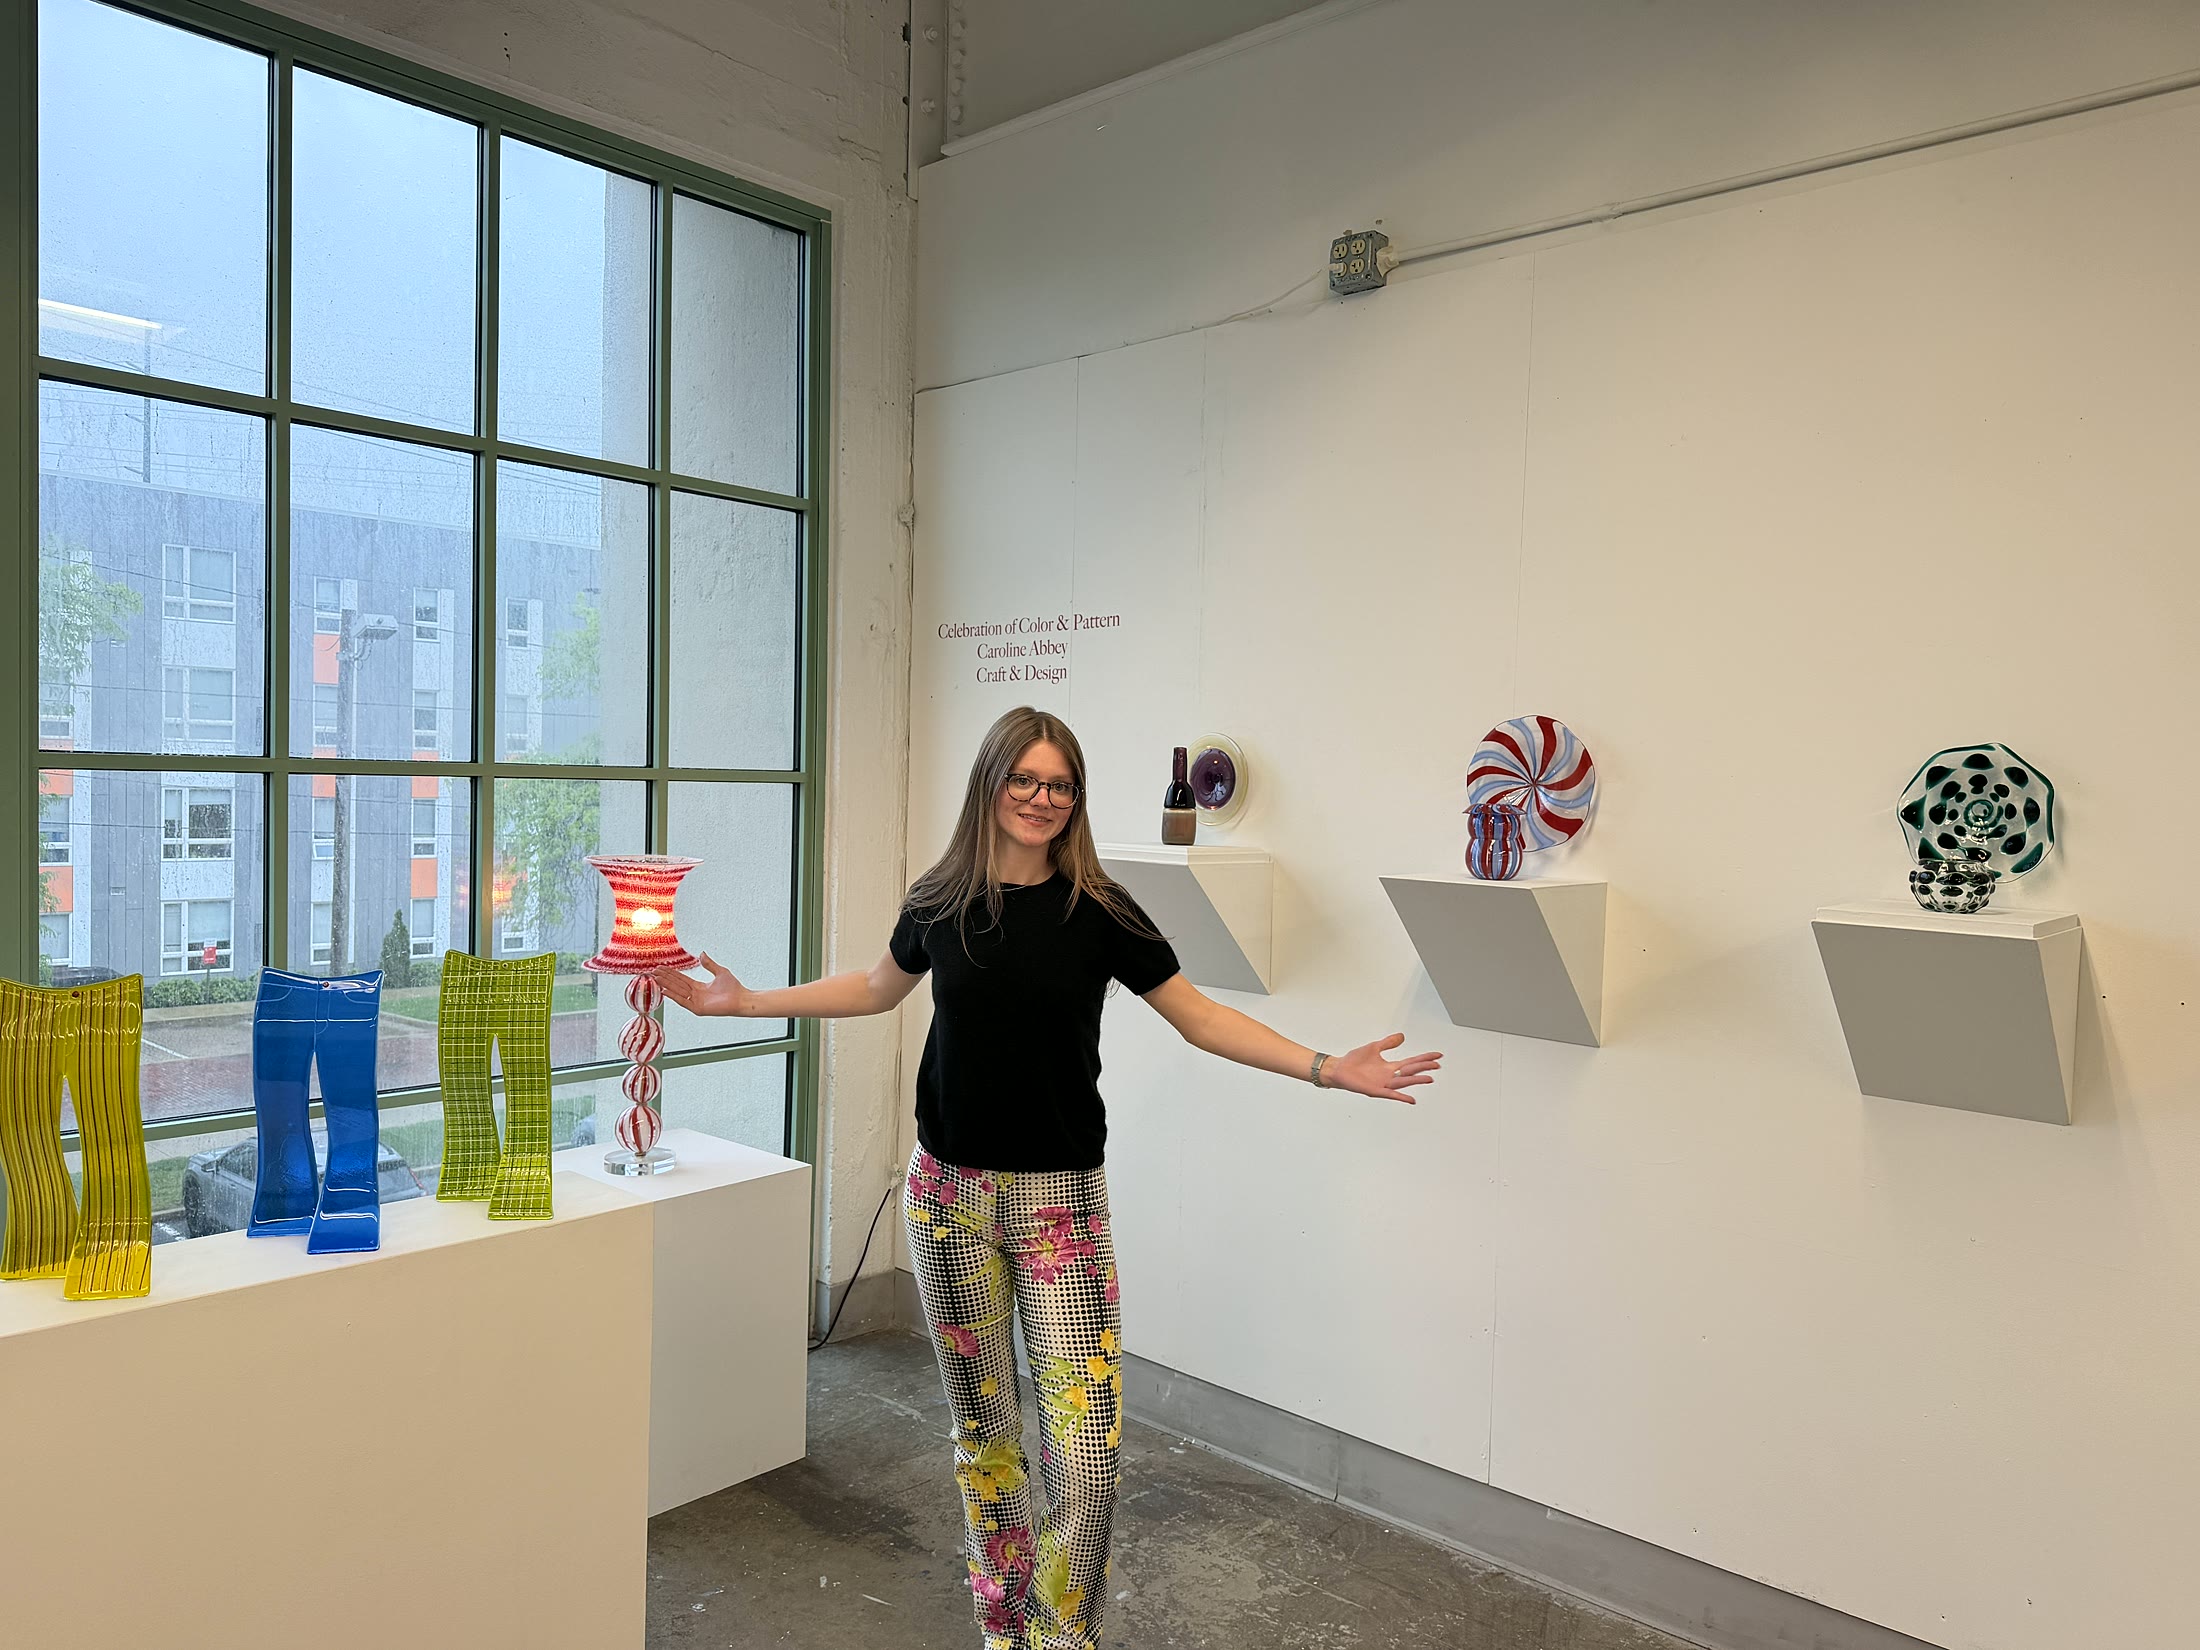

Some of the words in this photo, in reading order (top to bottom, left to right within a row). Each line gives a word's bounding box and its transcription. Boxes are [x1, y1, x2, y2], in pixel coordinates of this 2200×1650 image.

[938, 622, 1002, 639] Celebration
[1004, 619, 1018, 635] of
[1018, 617, 1054, 634] Color
[1056, 614, 1069, 631] &
[1073, 613, 1120, 631] Pattern
[977, 642, 1027, 659] Caroline
[1029, 640, 1068, 659] Abbey
[976, 666, 1006, 683] Craft
[1009, 665, 1021, 681] &
[1025, 664, 1067, 684] Design
